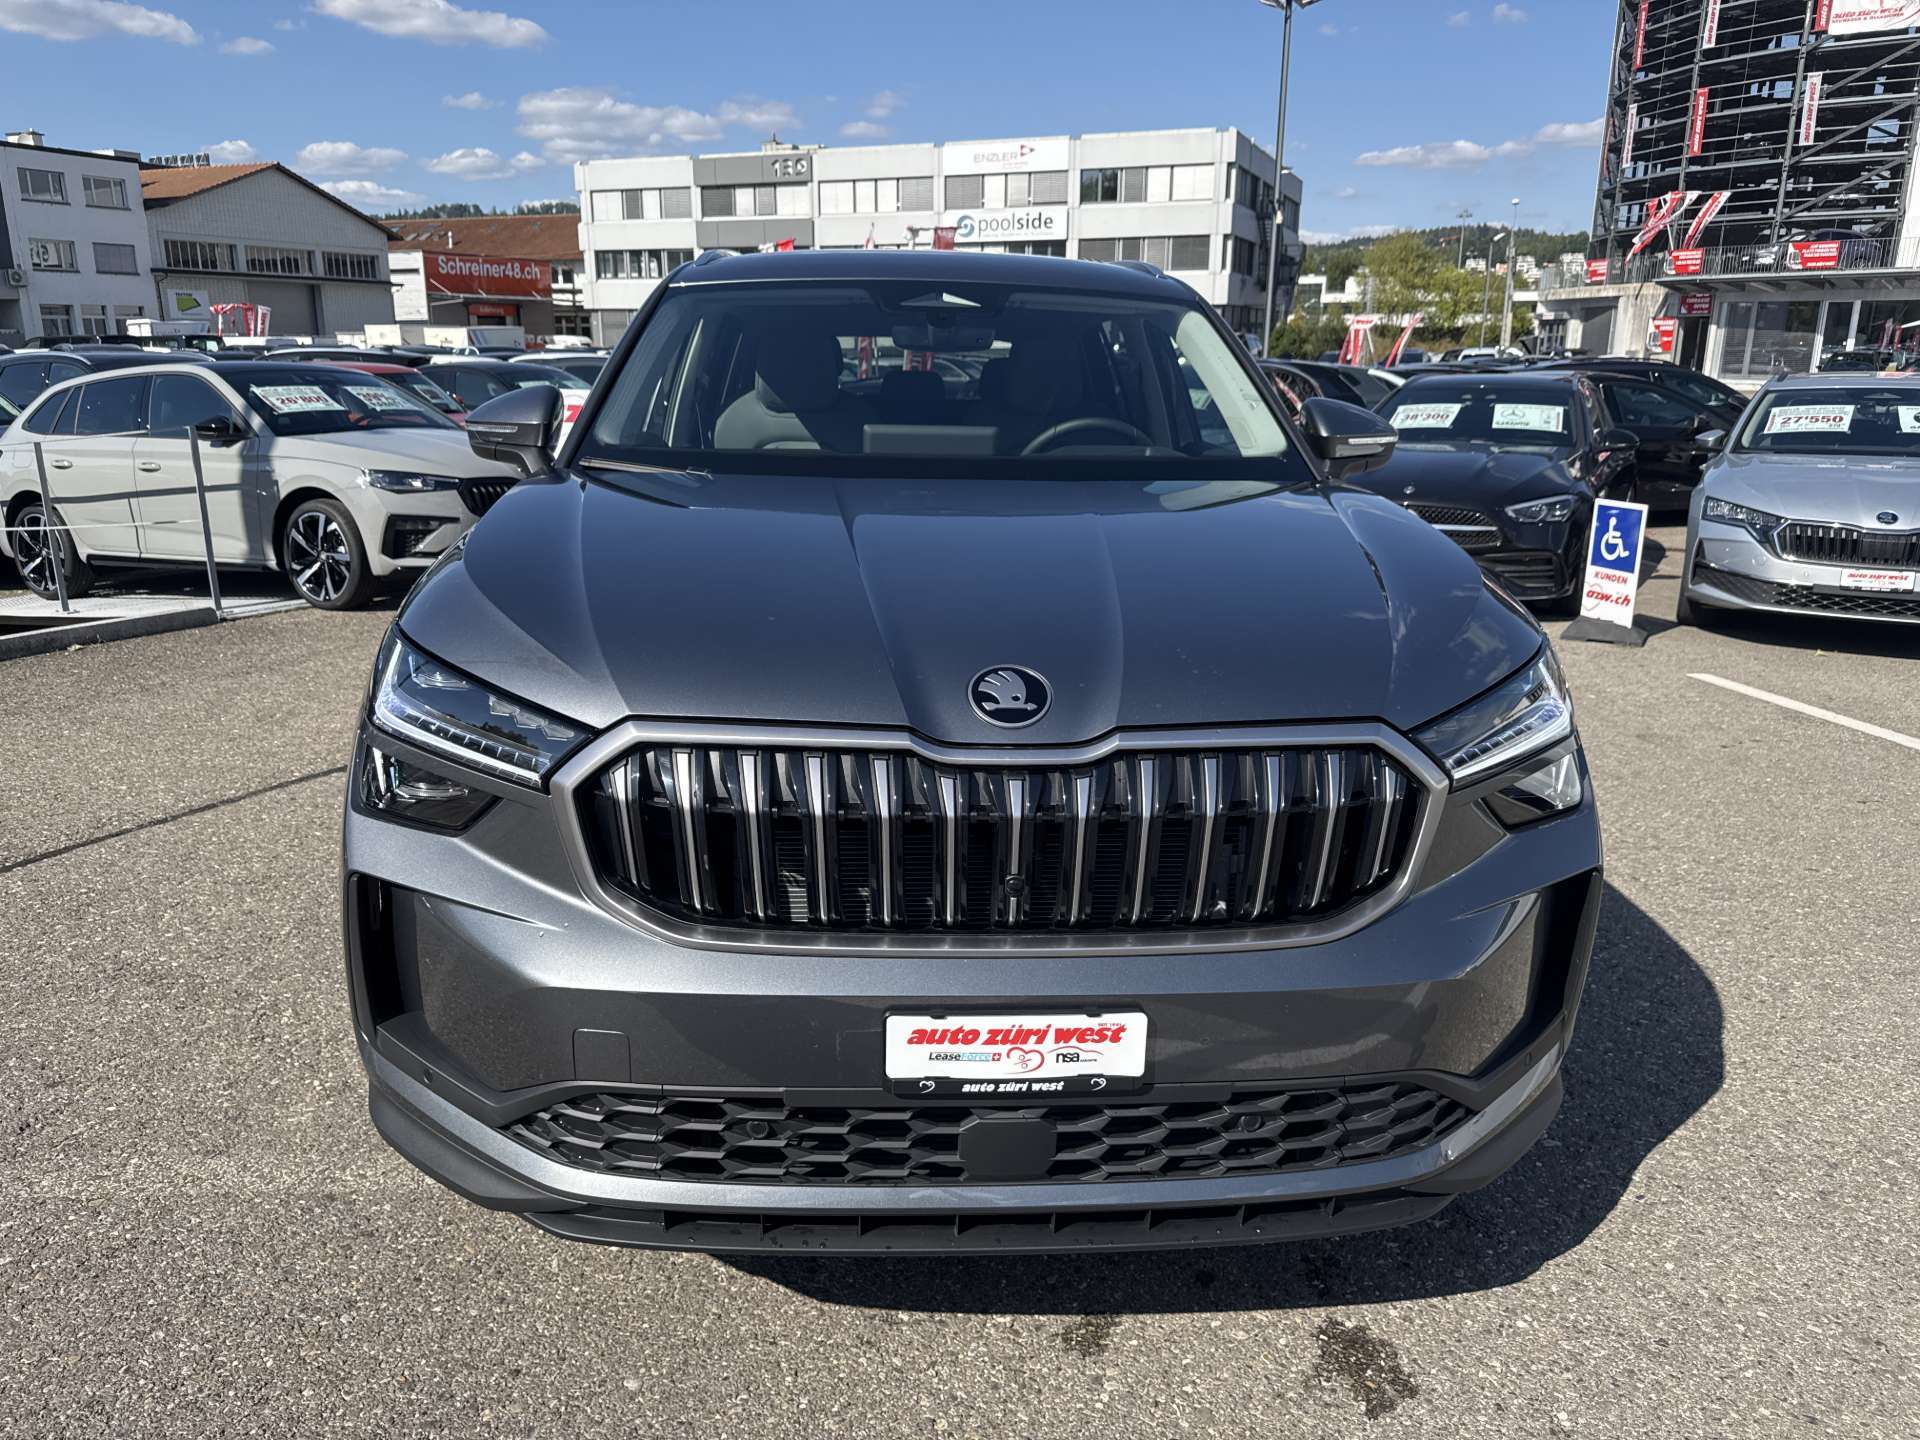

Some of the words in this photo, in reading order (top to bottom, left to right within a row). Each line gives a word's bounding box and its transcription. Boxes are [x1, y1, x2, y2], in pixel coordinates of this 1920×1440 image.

[979, 212, 1054, 240] poolside
[438, 255, 540, 280] Schreiner48.ch
[1780, 415, 1844, 425] 27'550
[1594, 571, 1629, 585] KUNDEN
[1586, 590, 1631, 607] azw.ch
[907, 1027, 980, 1046] auto
[981, 1024, 1051, 1046] züri
[1054, 1025, 1127, 1045] west
[928, 1052, 991, 1062] LeaseForce
[1055, 1052, 1080, 1063] nsa
[962, 1082, 994, 1093] auto
[997, 1080, 1028, 1093] züri
[1032, 1081, 1065, 1092] west
